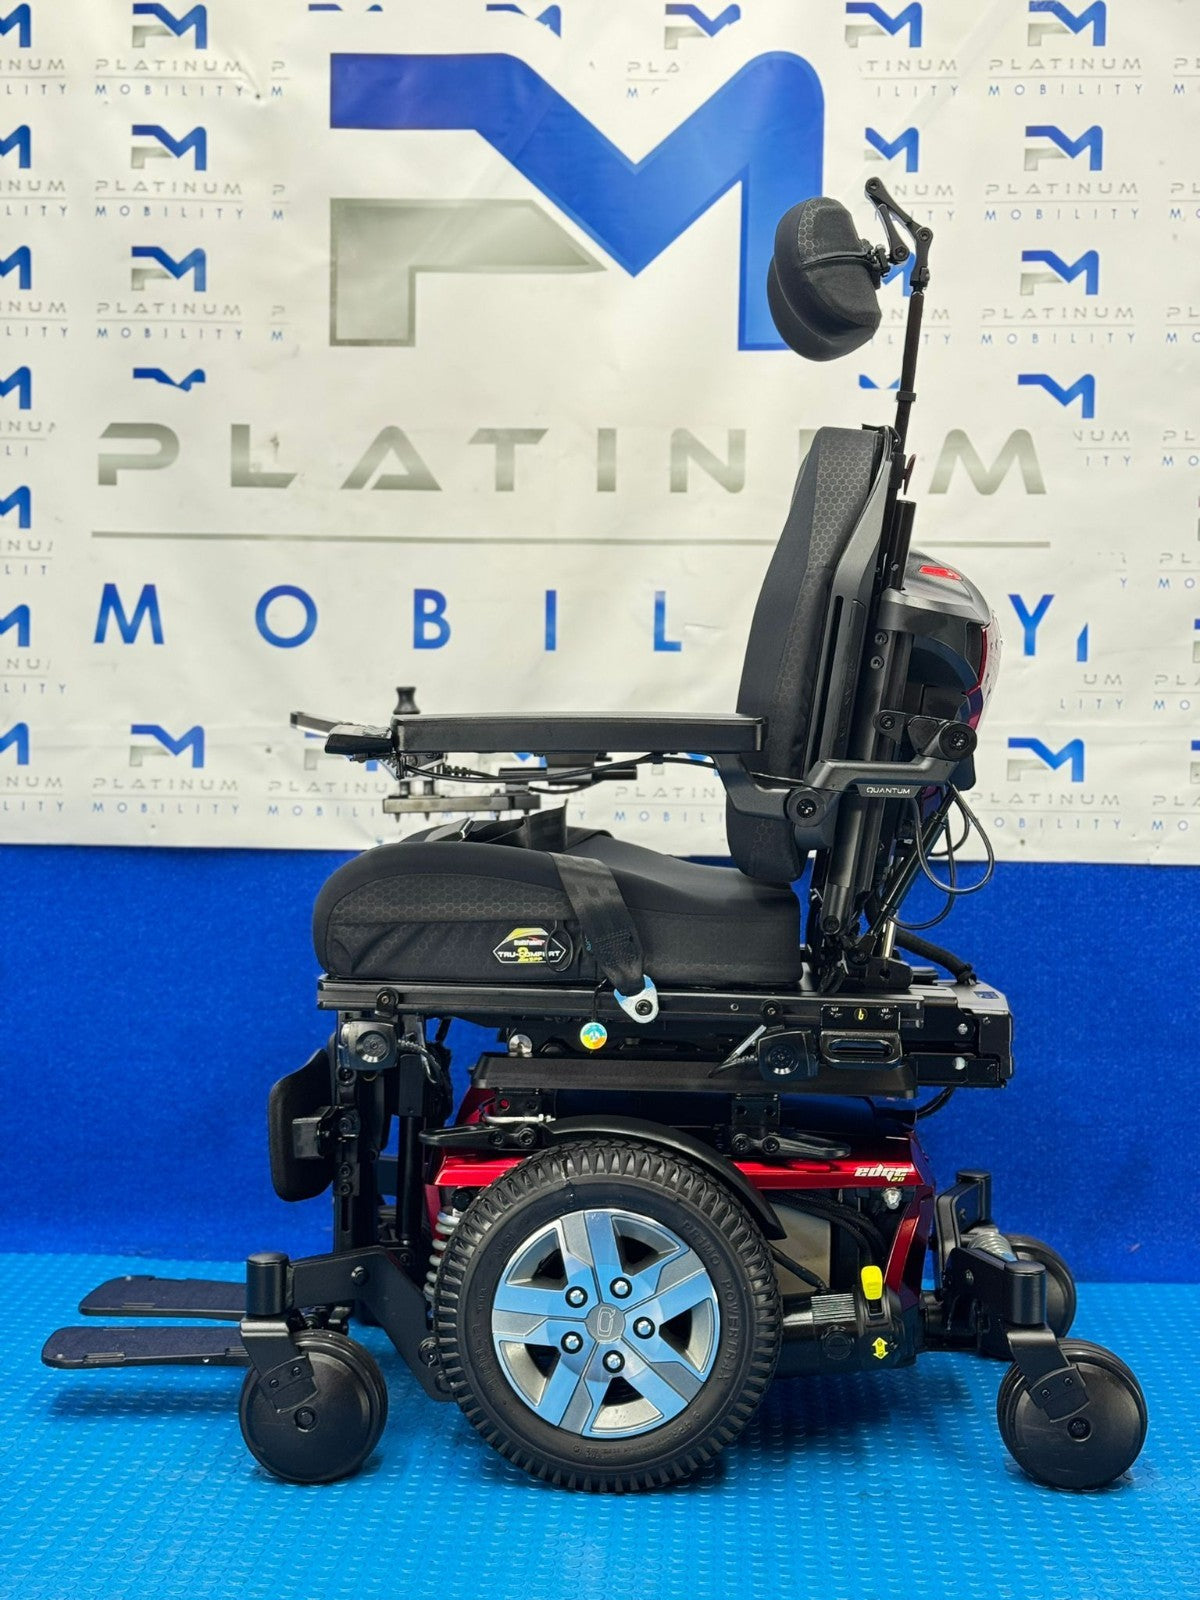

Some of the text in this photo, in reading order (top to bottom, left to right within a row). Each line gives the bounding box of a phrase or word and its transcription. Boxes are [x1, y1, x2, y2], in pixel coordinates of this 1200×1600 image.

[95, 59, 244, 74] PLATINUM
[866, 59, 957, 72] TINUM
[989, 58, 1141, 71] PLATINUM
[95, 83, 243, 98] MOBILITY
[988, 83, 1142, 98] MOBILITY
[95, 180, 242, 195] PLATINUM
[985, 182, 1138, 195] PLATINUM
[95, 205, 243, 220] MOBILITY
[984, 208, 1139, 221] MOBILITY
[97, 302, 241, 316] PLATINUM
[891, 309, 949, 319] NM
[982, 306, 1134, 320] PLATINUM
[96, 327, 242, 340] MOBILITY
[980, 330, 1134, 345] MOBILITY
[94, 583, 1054, 656] MOBILY
[92, 777, 239, 791] PLATINUM
[268, 780, 388, 794] PLATINU
[615, 786, 716, 799] PLATIN
[970, 792, 1120, 805] PLATINUM
[92, 802, 239, 814] MOBILITY
[268, 806, 412, 817] MOBILI
[614, 810, 722, 823] MOBILI
[970, 818, 1121, 829] OBILITY
[854, 1163, 915, 1182] edge
